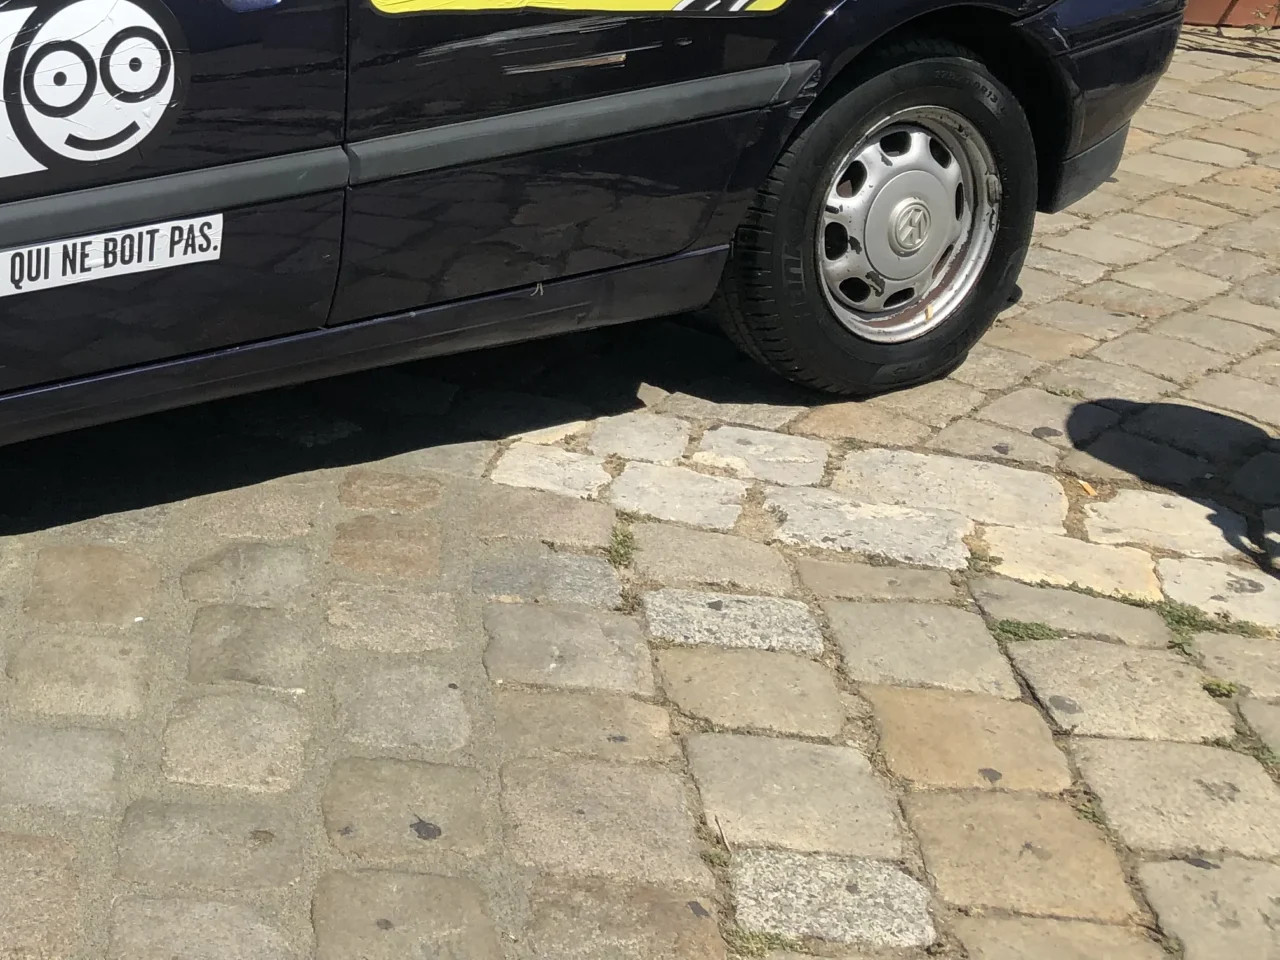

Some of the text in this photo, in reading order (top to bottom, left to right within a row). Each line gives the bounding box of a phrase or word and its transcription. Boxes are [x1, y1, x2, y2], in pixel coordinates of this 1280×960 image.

[9, 246, 51, 290] QUI
[61, 240, 93, 277] NE
[103, 228, 160, 269] BOIT
[169, 221, 219, 258] PAS.
